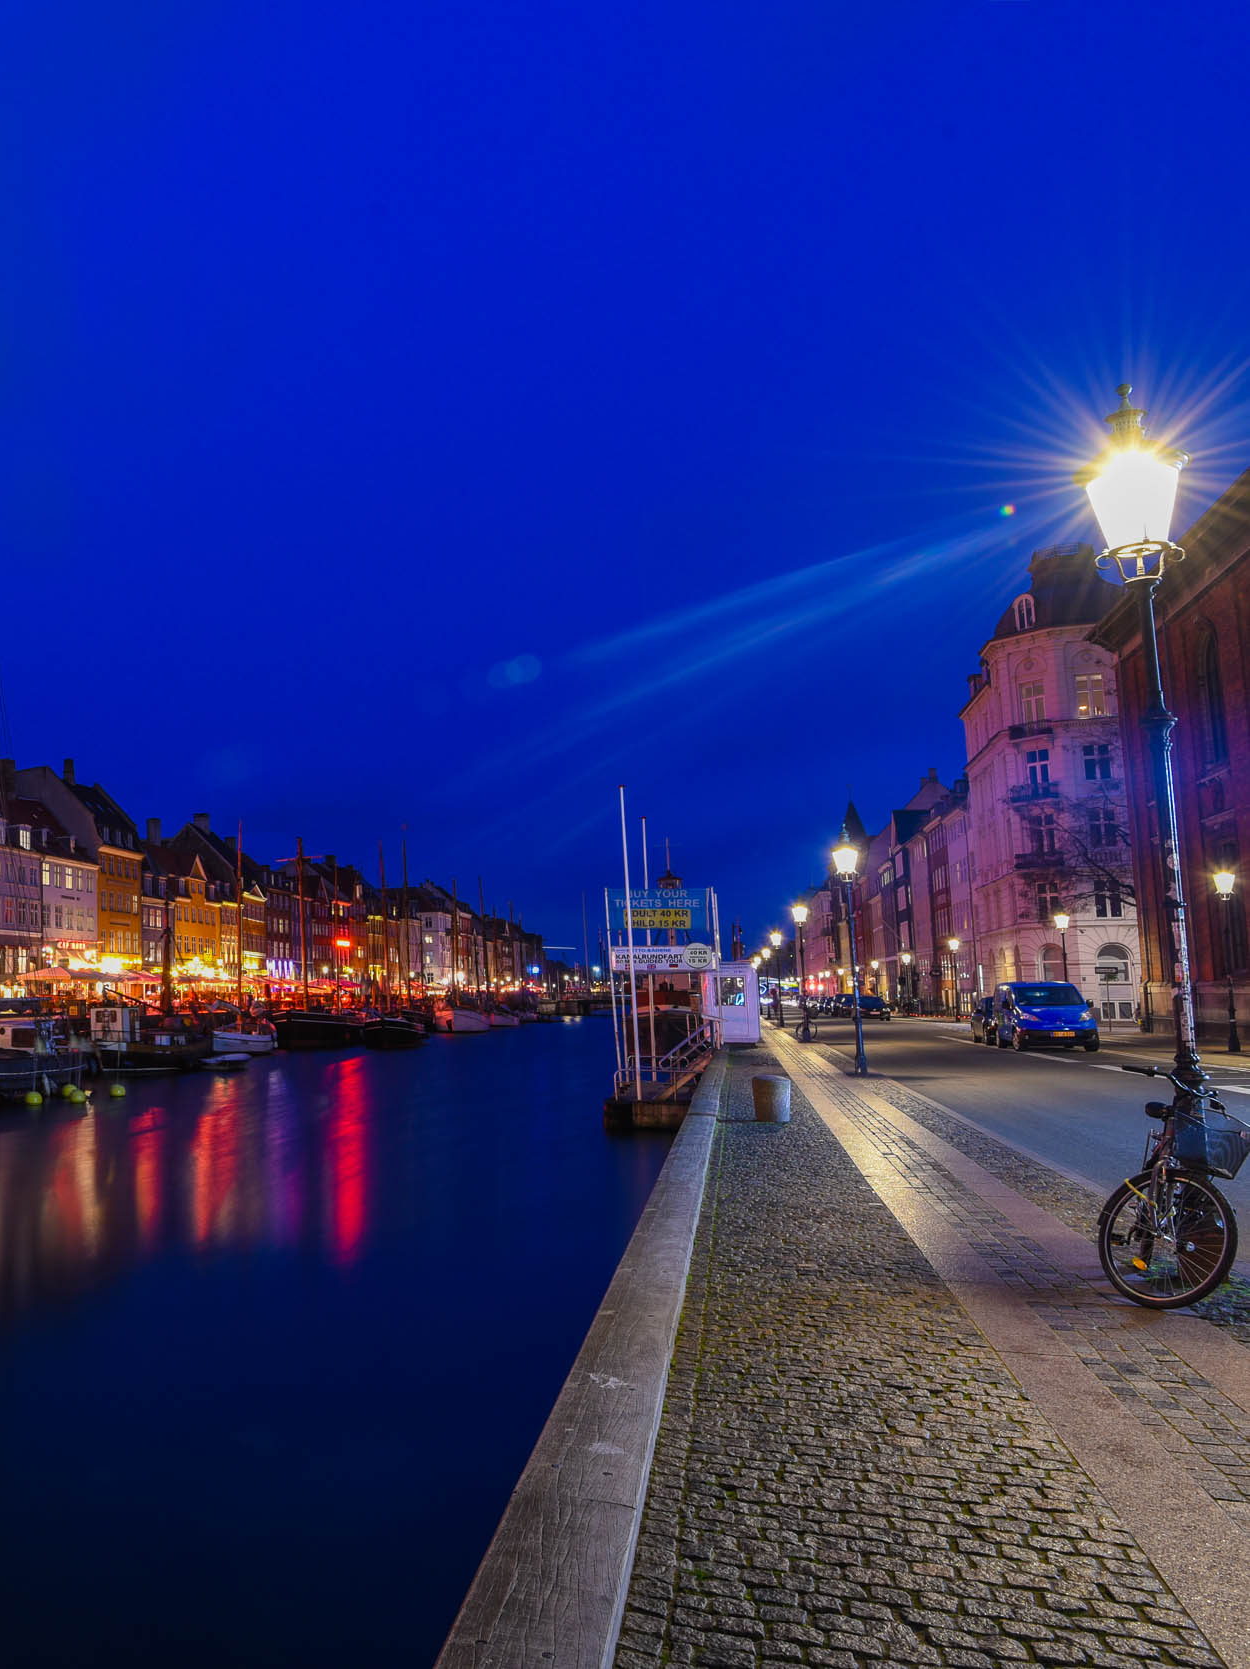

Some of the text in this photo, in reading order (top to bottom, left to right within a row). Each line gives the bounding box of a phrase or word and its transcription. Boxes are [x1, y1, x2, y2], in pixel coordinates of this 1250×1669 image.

[655, 890, 688, 898] YOUR
[614, 899, 700, 908] TIKETS HERE
